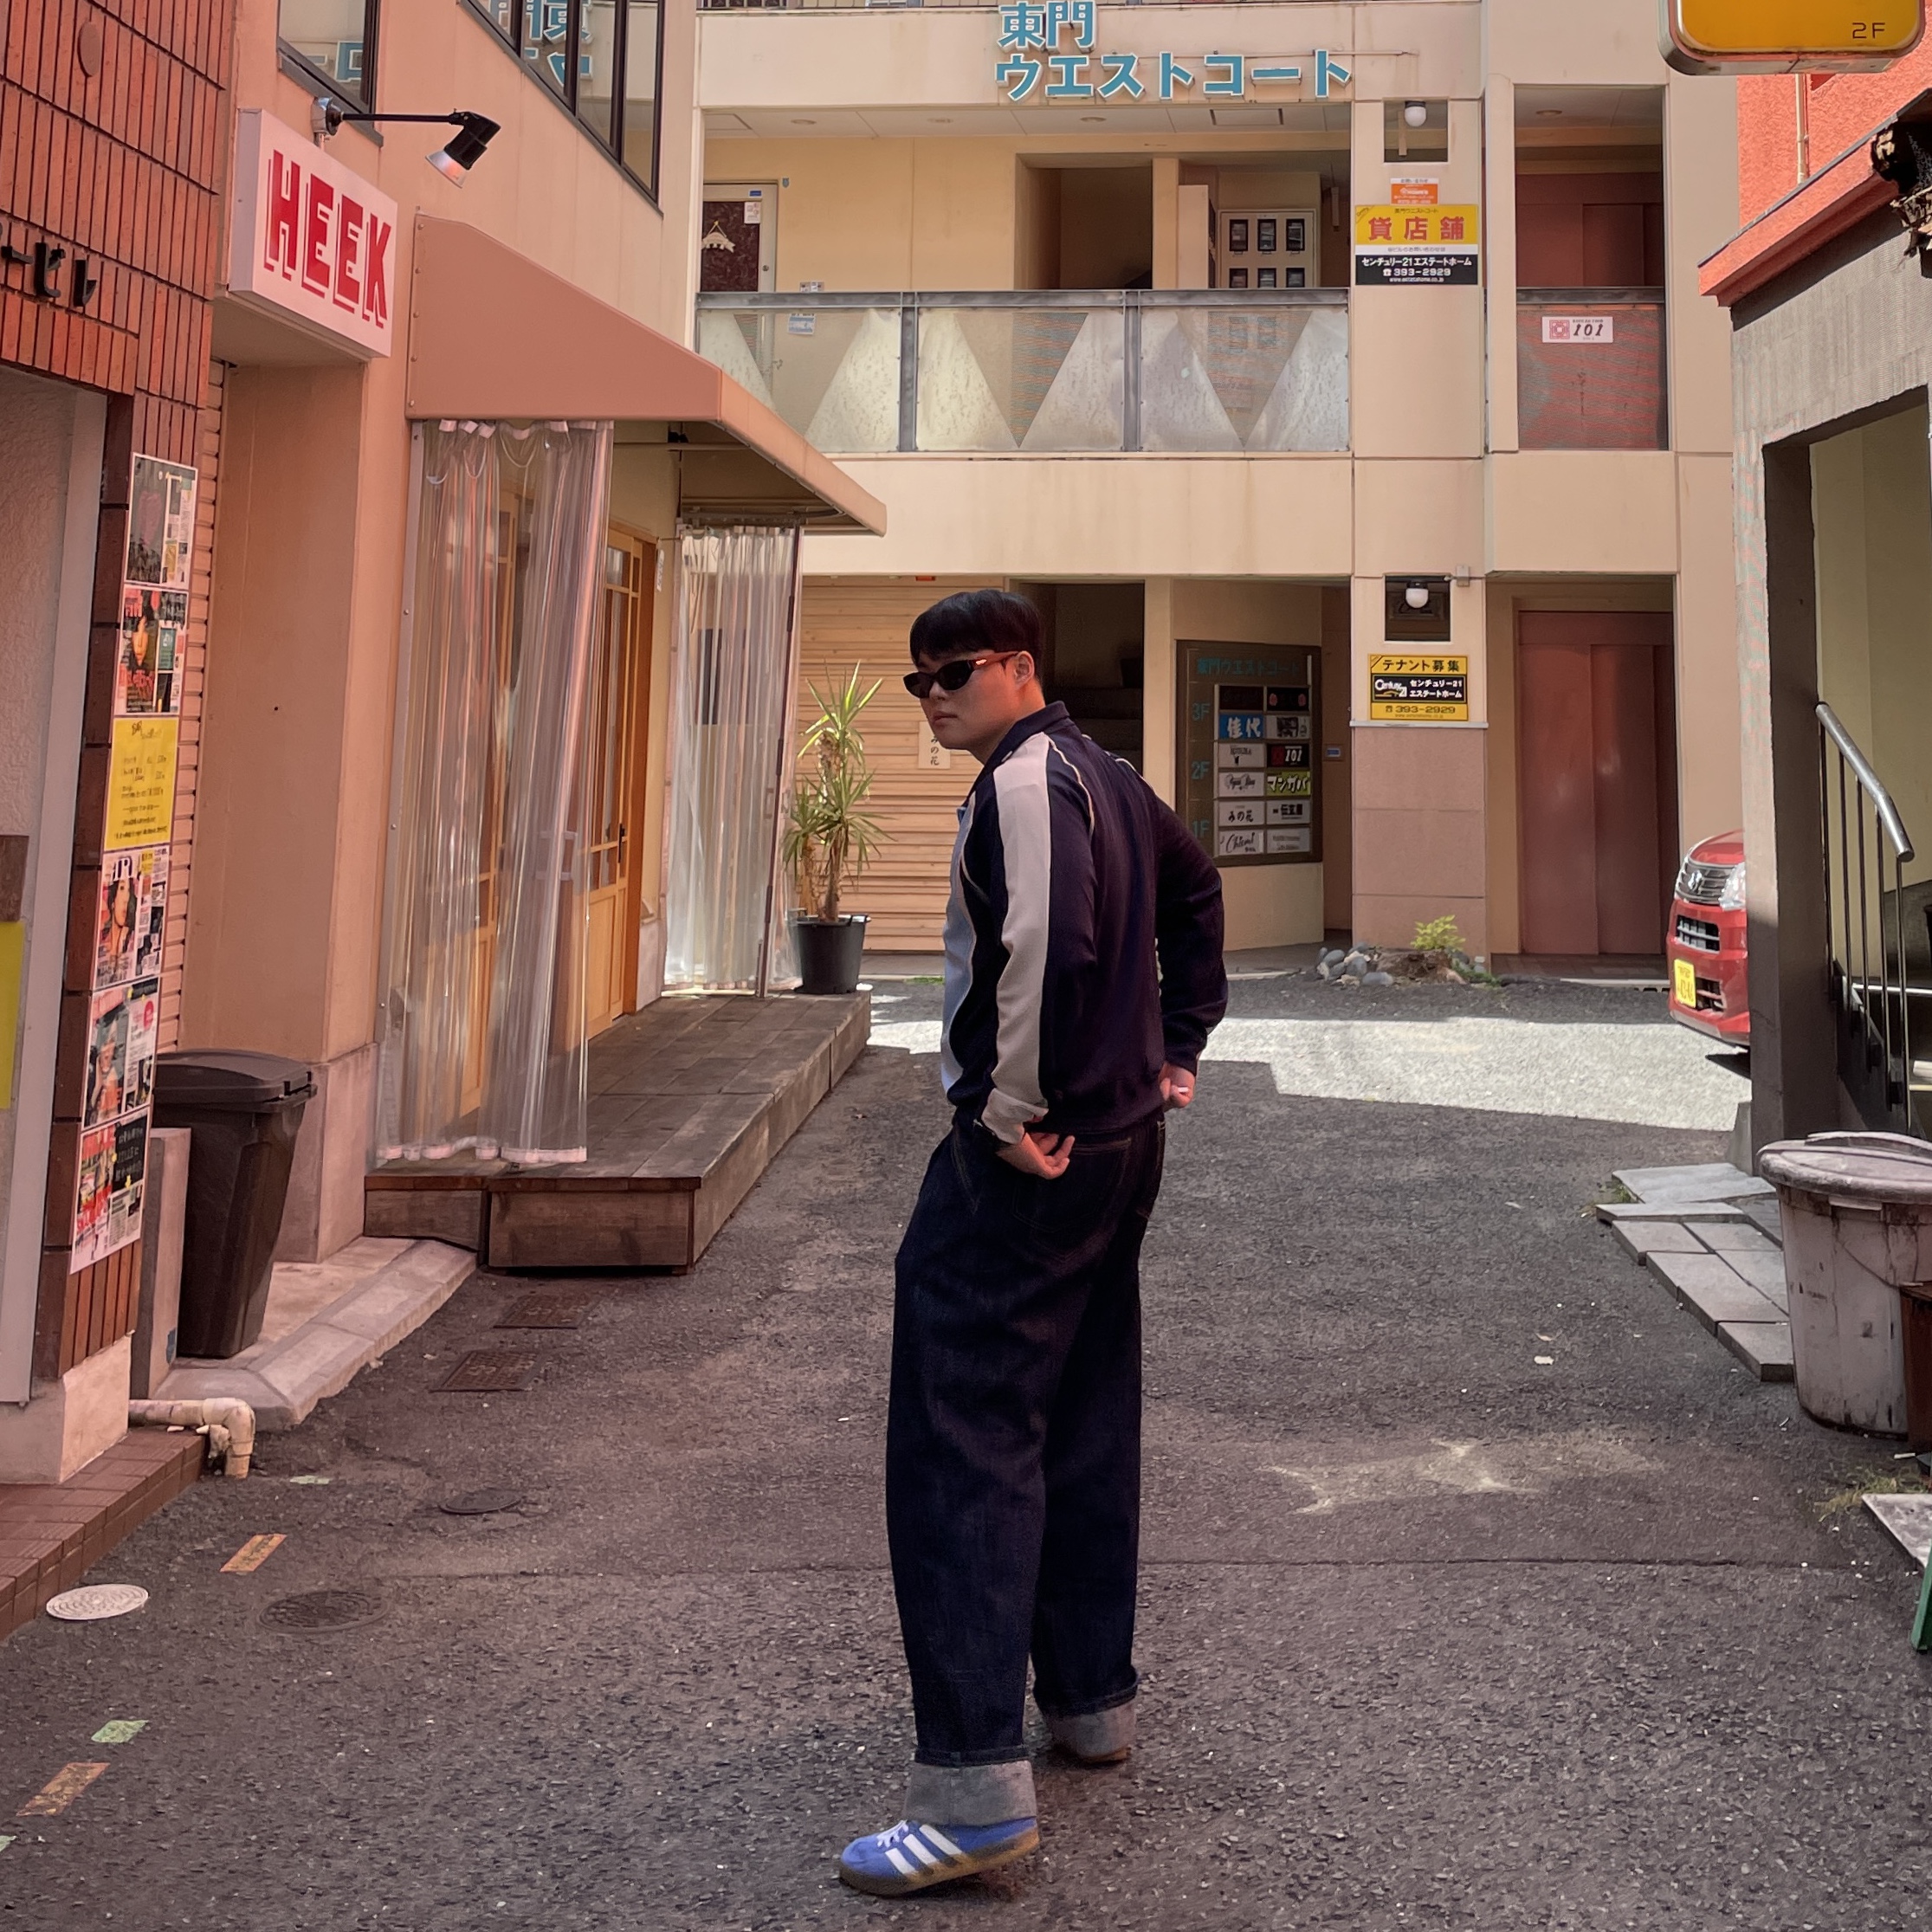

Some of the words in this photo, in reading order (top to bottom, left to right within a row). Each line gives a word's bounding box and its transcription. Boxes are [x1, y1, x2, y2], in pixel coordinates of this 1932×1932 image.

[998, 1, 1097, 52] 東門
[1851, 22, 1885, 39] 2F
[995, 49, 1352, 102] ウエストコート
[1368, 216, 1464, 242] 貸店舗
[263, 149, 392, 329] HEEK
[1393, 268, 1451, 277] 393-2929
[1573, 323, 1604, 337] 101
[1382, 659, 1460, 672] テナント募集
[1409, 690, 1463, 699] エステートホーム
[1395, 706, 1456, 714] 393-2929
[1284, 748, 1303, 763] 101
